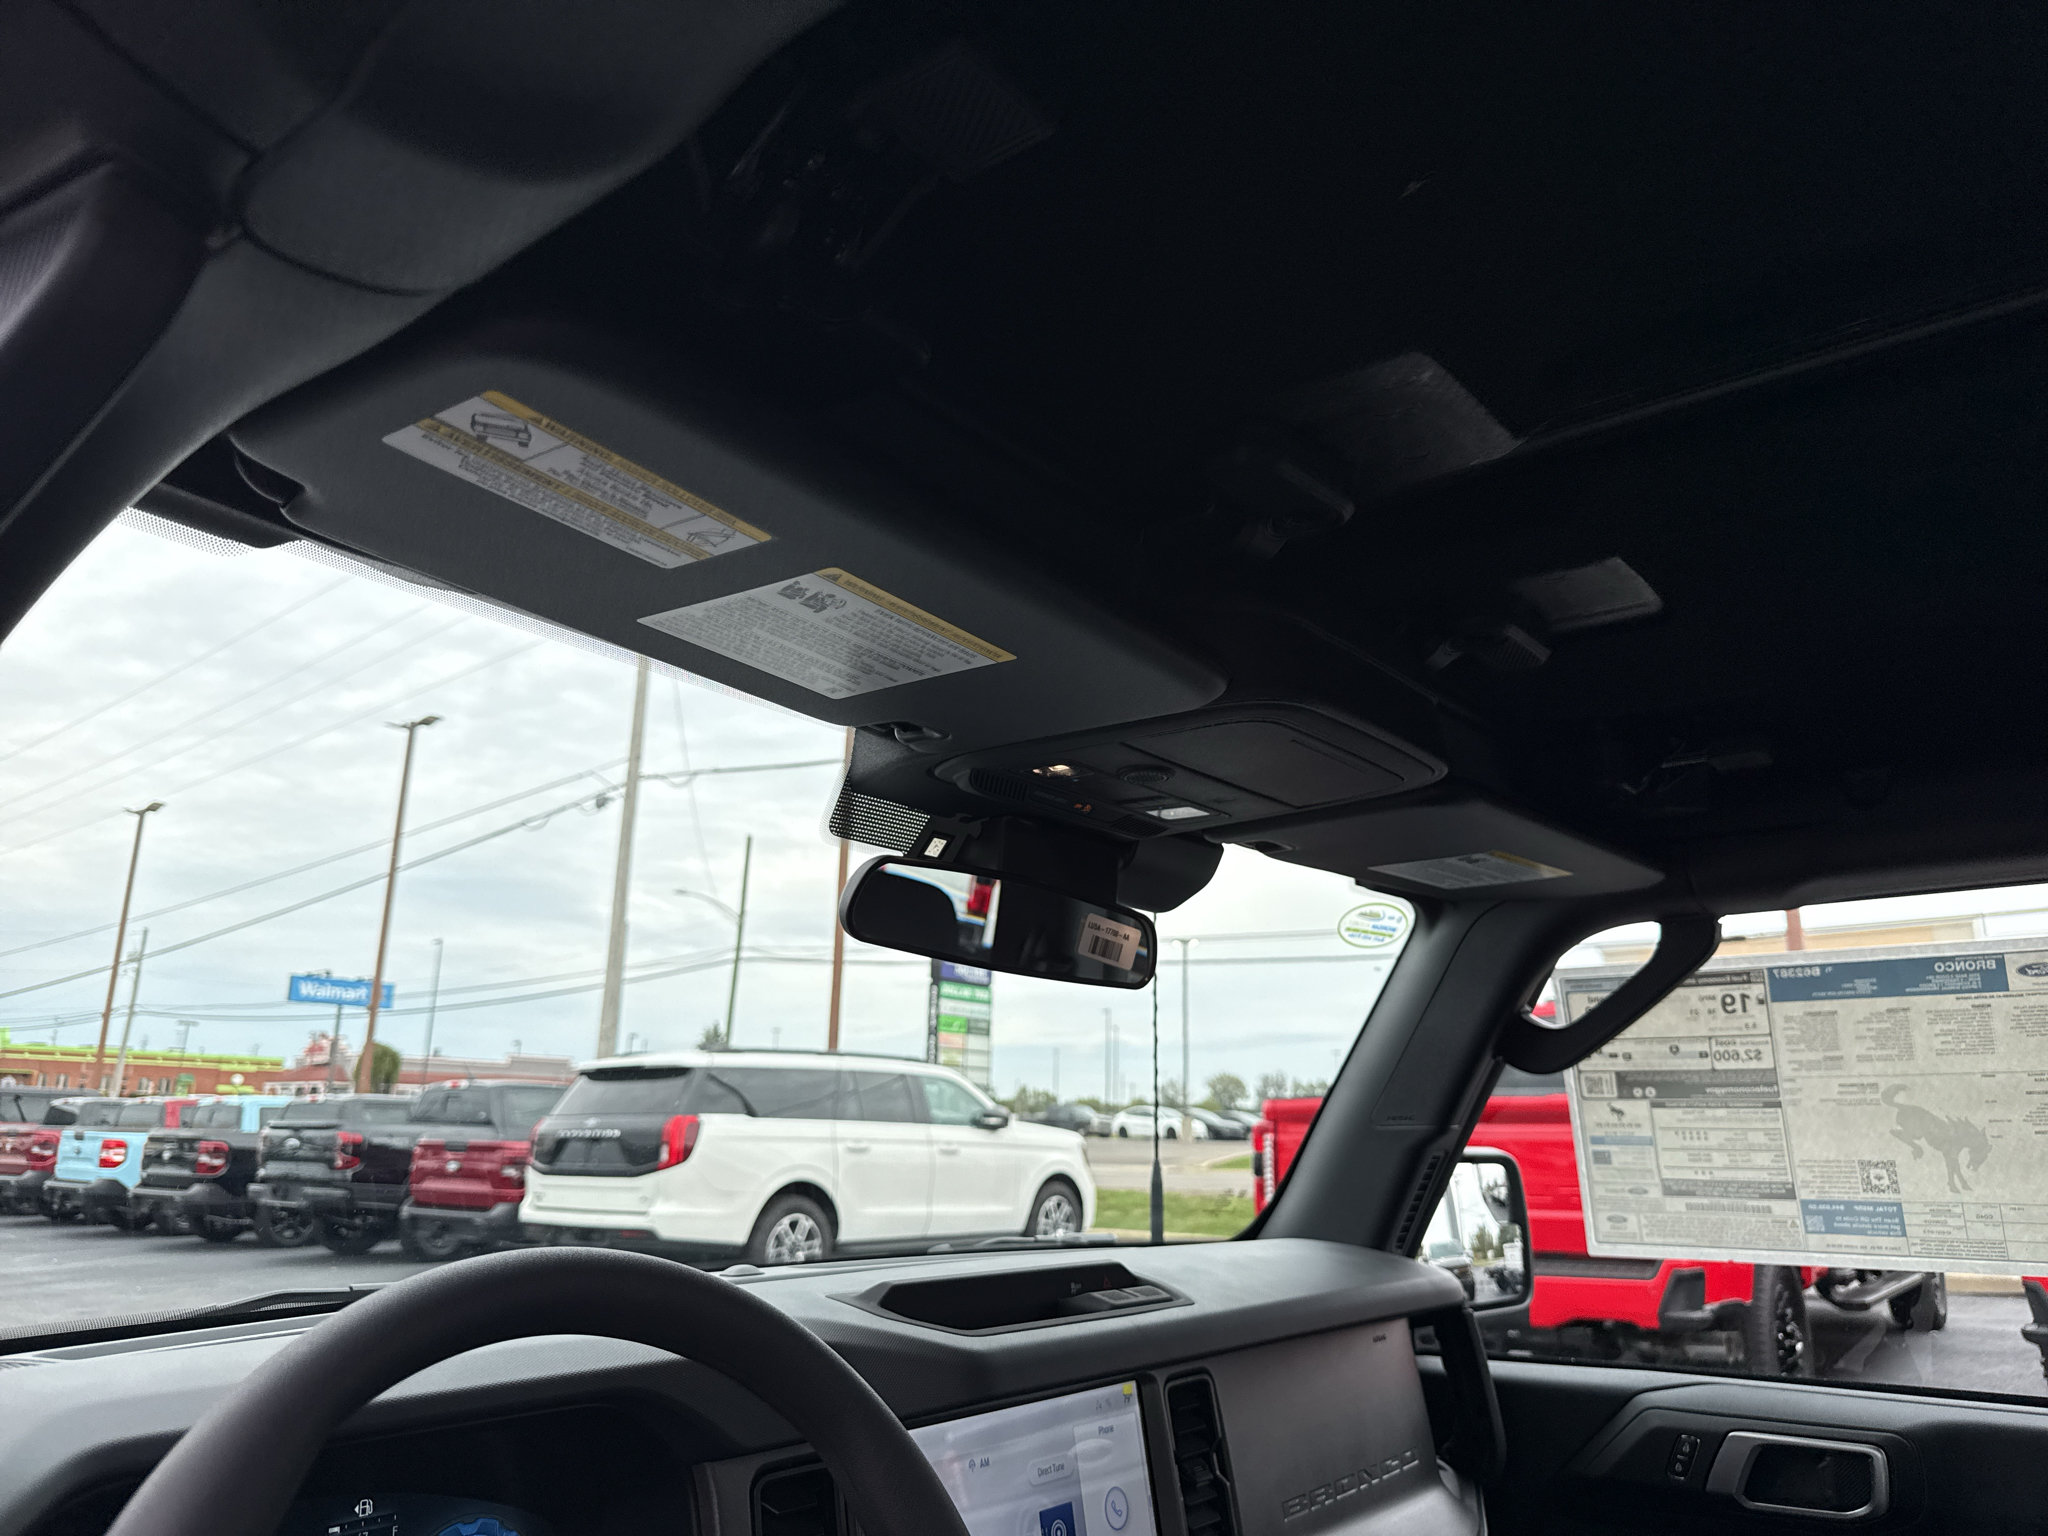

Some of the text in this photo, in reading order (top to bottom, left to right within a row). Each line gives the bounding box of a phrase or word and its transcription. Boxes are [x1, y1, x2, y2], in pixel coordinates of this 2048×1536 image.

[299, 980, 368, 1000] Walmart
[1098, 1424, 1114, 1435] Phone
[979, 1457, 990, 1469] AM
[1037, 1463, 1065, 1478] Direct Tune
[1282, 1448, 1420, 1523] BRONCO
